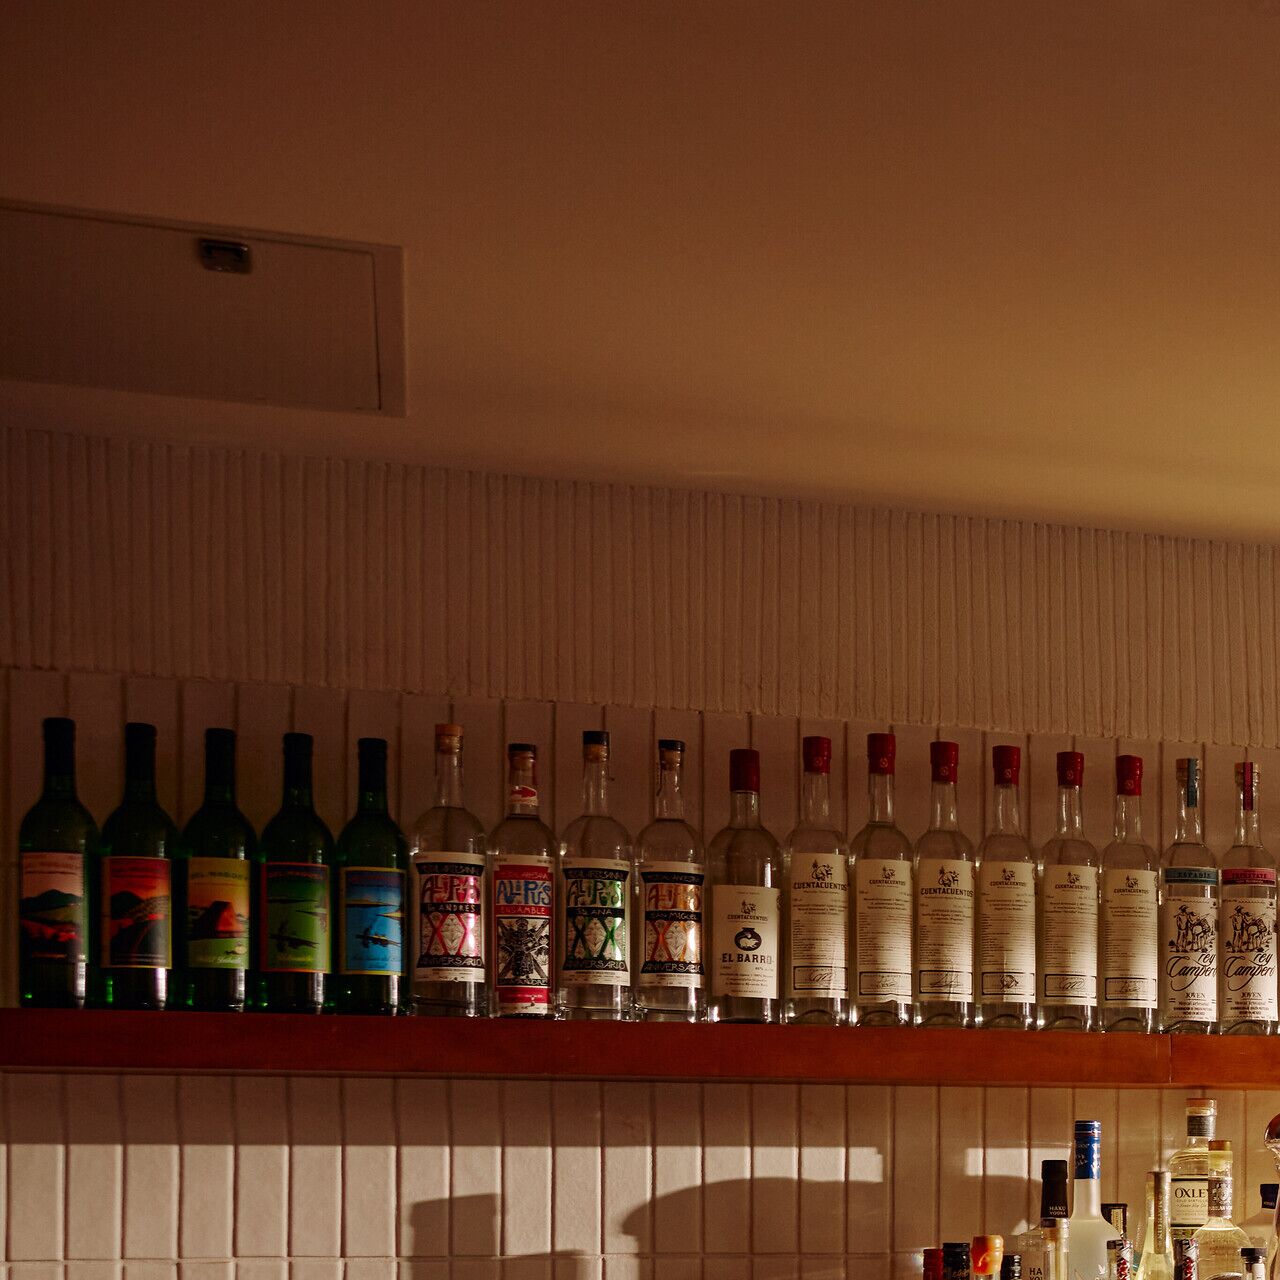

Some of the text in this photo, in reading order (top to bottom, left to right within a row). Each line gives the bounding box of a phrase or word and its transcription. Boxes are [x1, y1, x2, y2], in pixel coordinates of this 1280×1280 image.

[793, 880, 848, 892] CUENTACUENTOS
[920, 886, 974, 899] CUENTACUENTOS
[722, 952, 773, 966] EL BARRO
